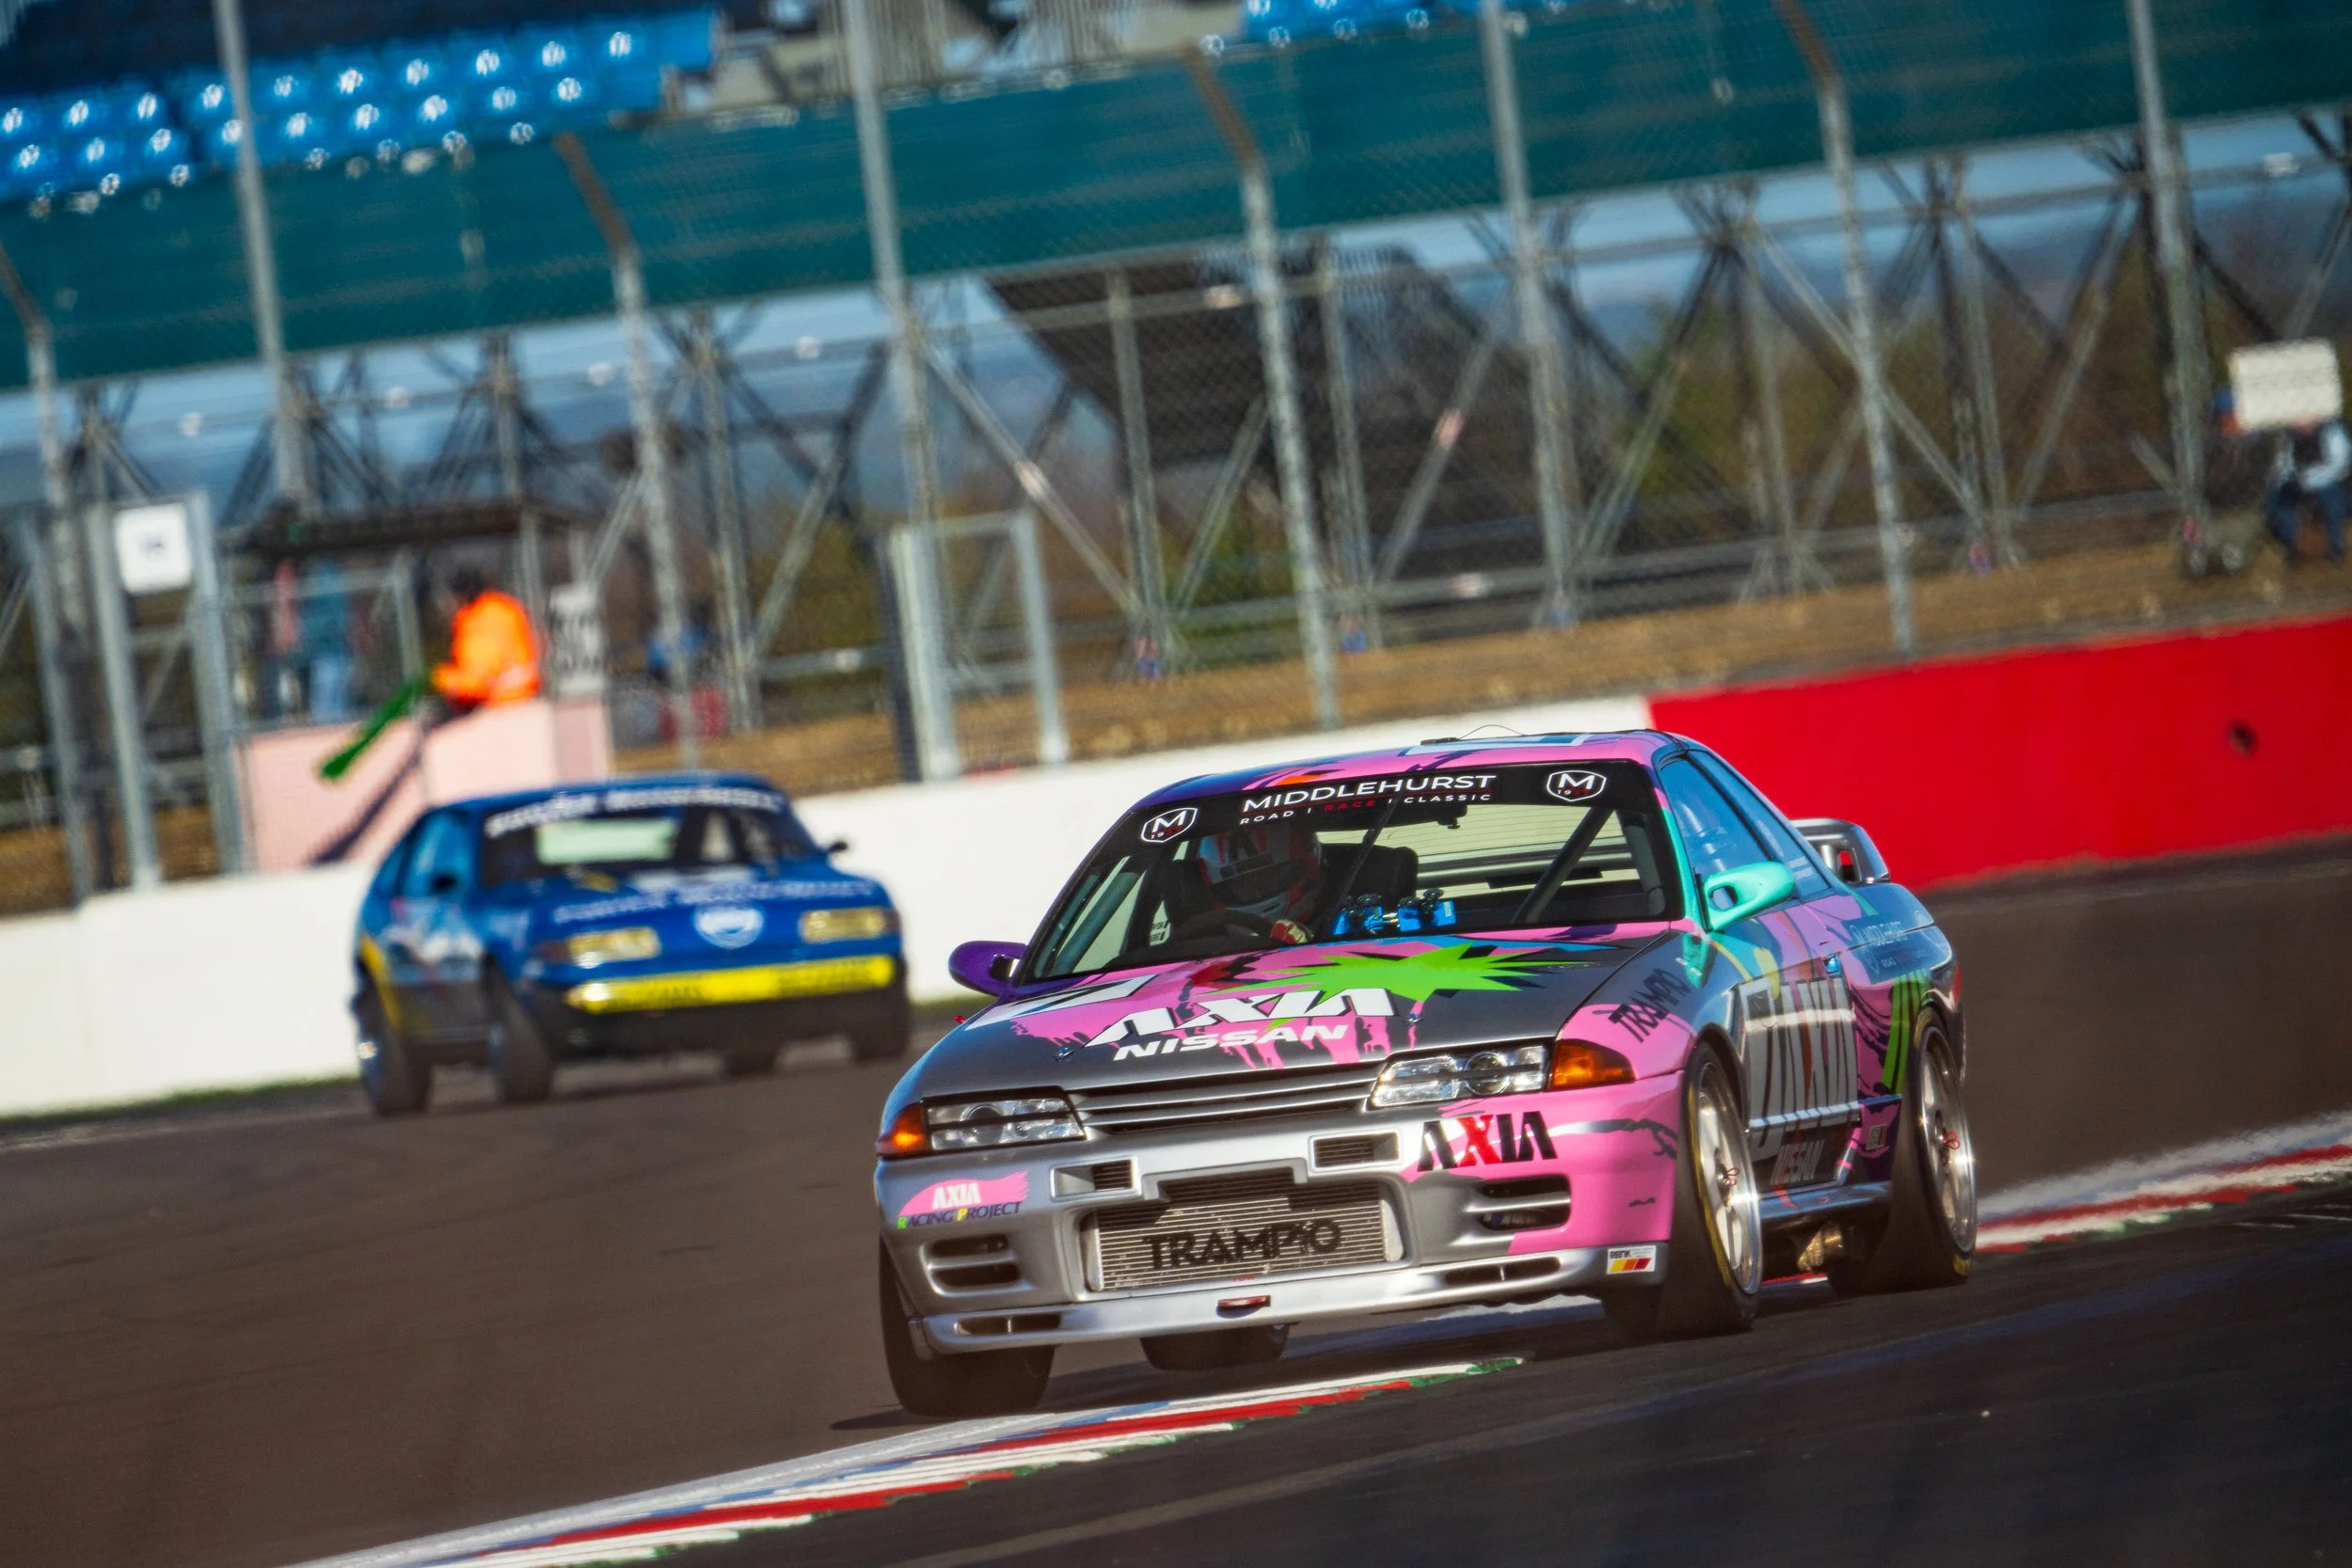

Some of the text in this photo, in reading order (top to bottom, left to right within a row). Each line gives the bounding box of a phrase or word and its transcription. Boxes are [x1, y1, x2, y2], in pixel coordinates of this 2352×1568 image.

[1239, 794, 1491, 826] ROAD RACE CLASSIC
[1243, 775, 1497, 813] MIDDLEHURST
[1084, 988, 1397, 1049] AXIA
[1112, 1024, 1349, 1062] NISSAN
[1417, 1110, 1558, 1173] AXIA
[897, 1200, 1023, 1230] RACING PROJECT
[931, 1182, 982, 1210] AXIA
